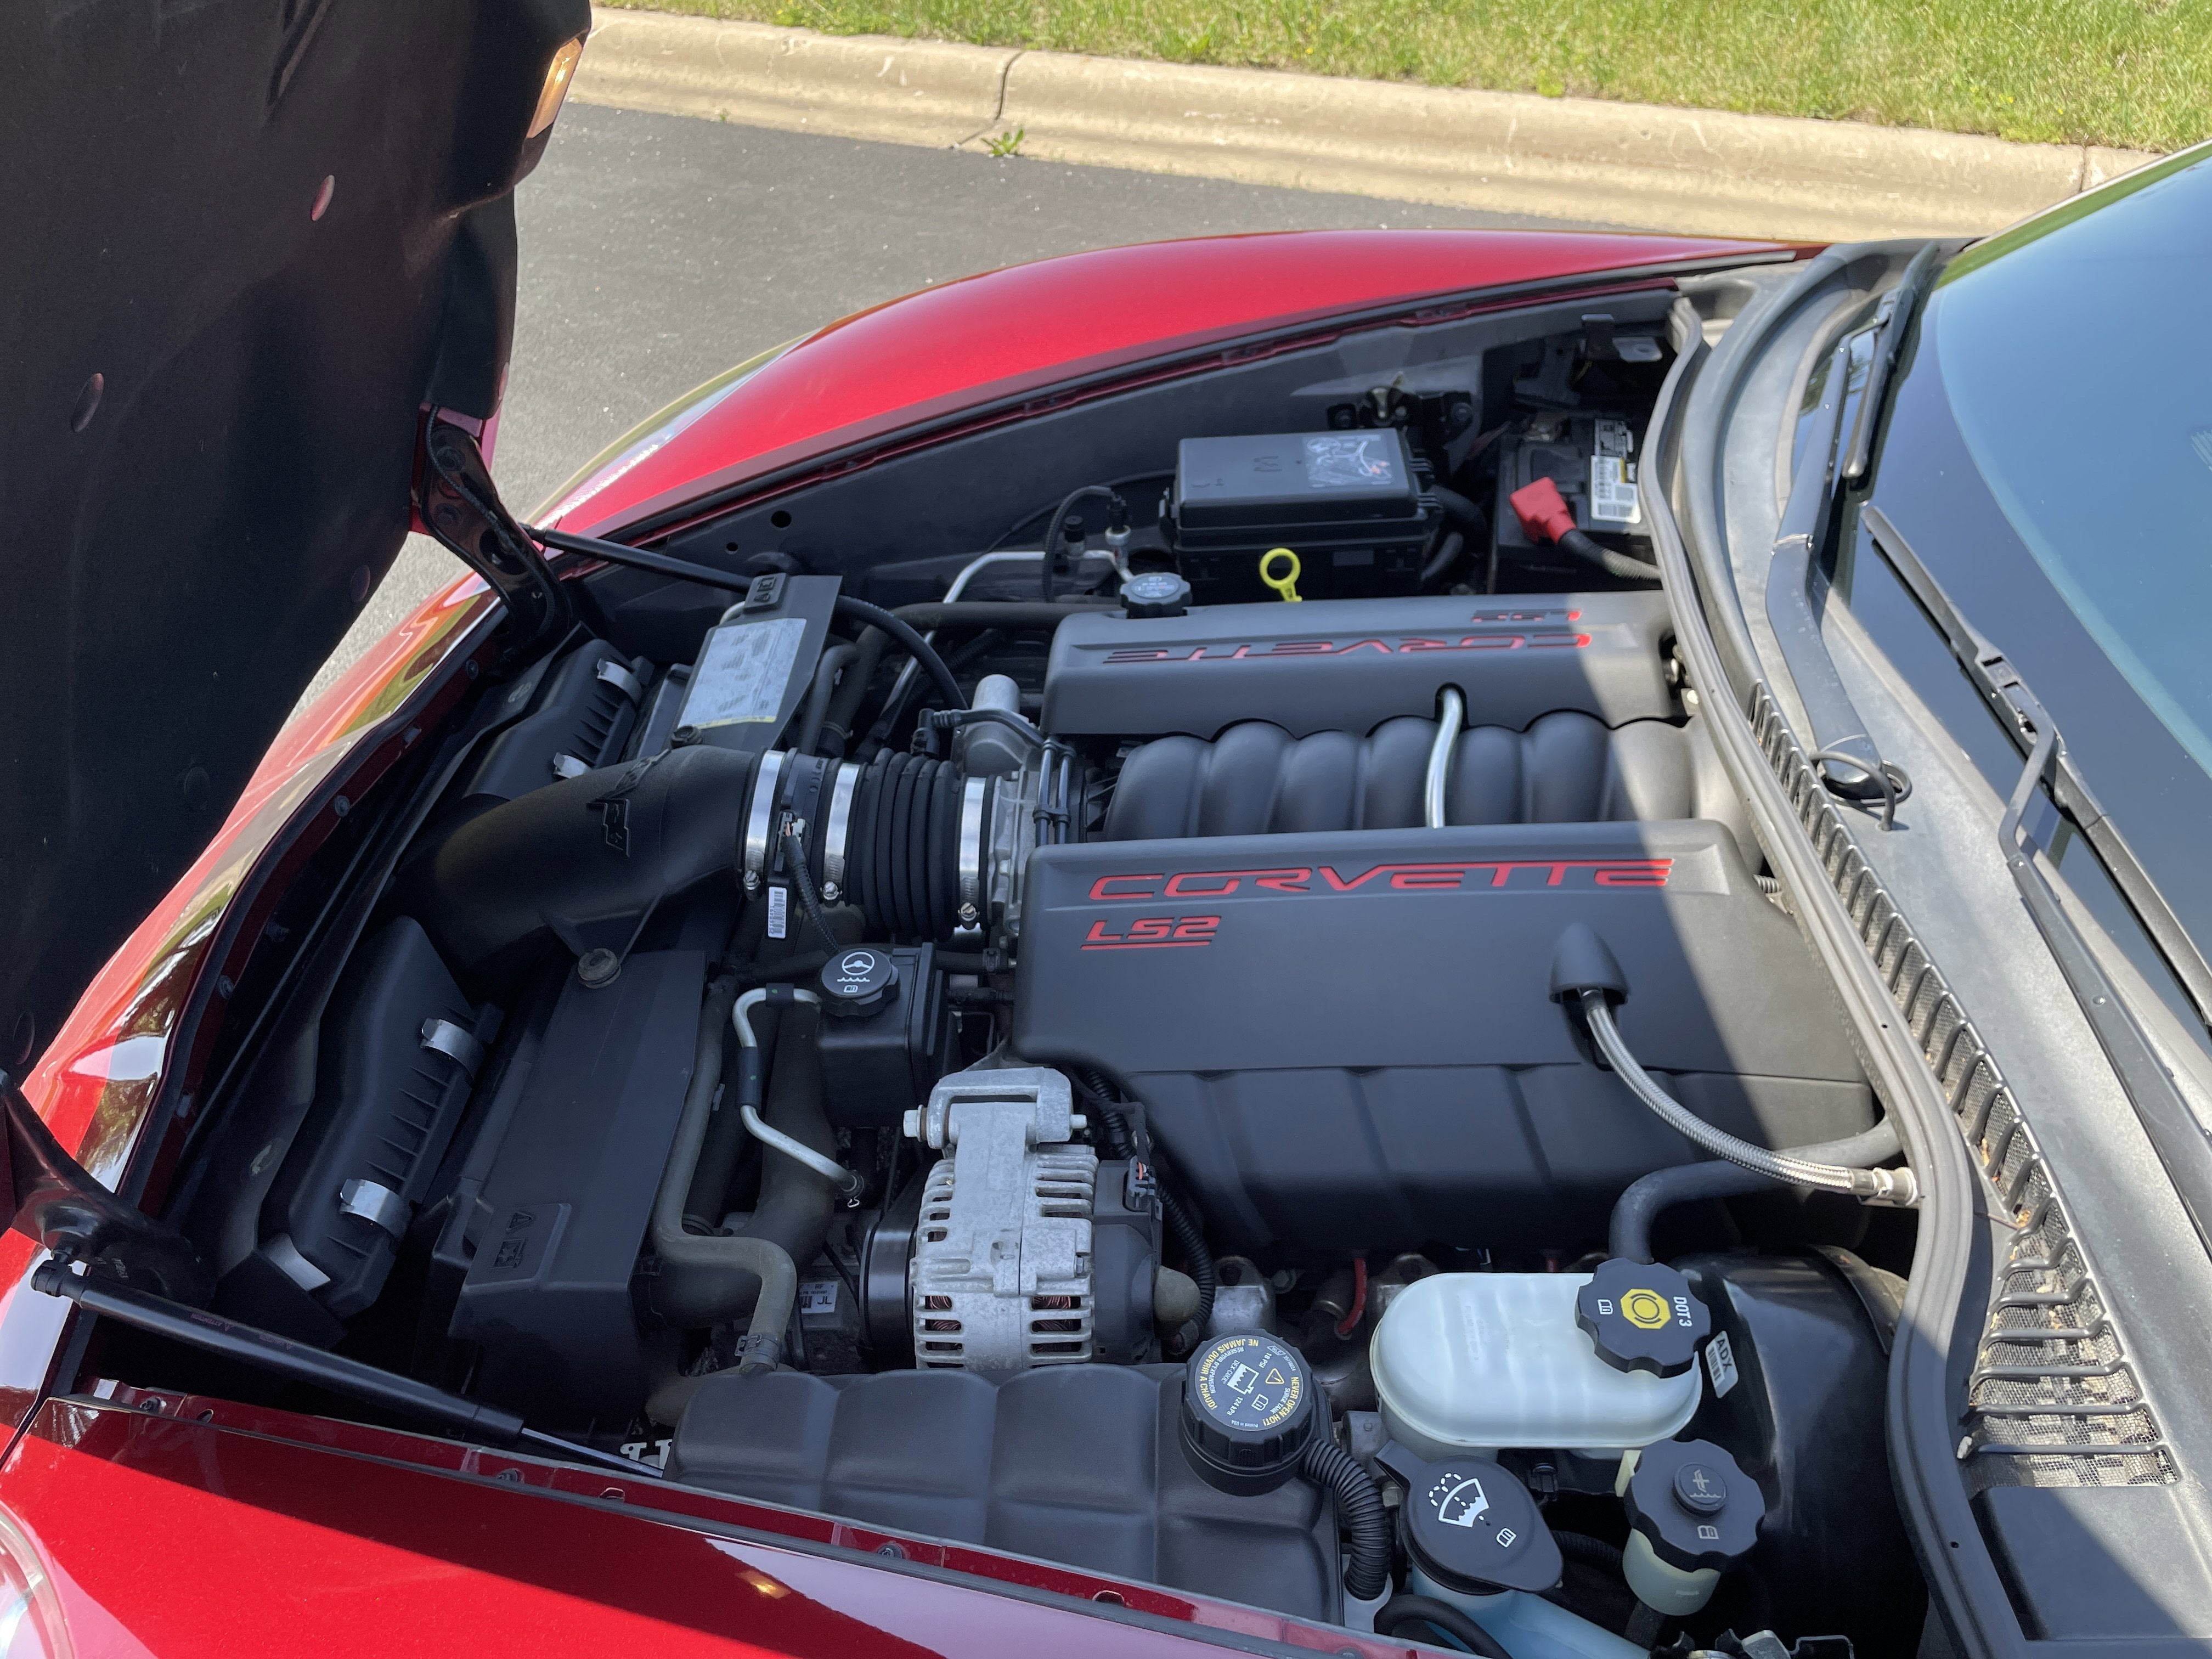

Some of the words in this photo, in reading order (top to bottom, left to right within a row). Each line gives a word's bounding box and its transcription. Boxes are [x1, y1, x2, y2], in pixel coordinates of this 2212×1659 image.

[1102, 633, 1593, 664] CORVETTE
[1088, 857, 1675, 900] CORVETTE
[1083, 915, 1221, 942] LS2
[817, 1295, 832, 1305] JL
[1673, 1296, 1691, 1319] DOT
[1678, 1318, 1693, 1327] 3
[1217, 1339, 1246, 1353] JAMAIS
[1248, 1339, 1259, 1347] NE
[1200, 1351, 1219, 1375] OUVRIR
[1259, 1358, 1268, 1368] PSI
[1717, 1338, 1733, 1373] ADX
[1200, 1383, 1218, 1410] CHAUD!
[1280, 1387, 1291, 1404] SURGE
[1290, 1376, 1300, 1400] NEVER
[1233, 1396, 1243, 1406] 124
[1270, 1402, 1284, 1414] TANK
[1278, 1400, 1296, 1418] OPEN
[1227, 1405, 1238, 1415] kPa
[1262, 1414, 1282, 1426] HOT!
